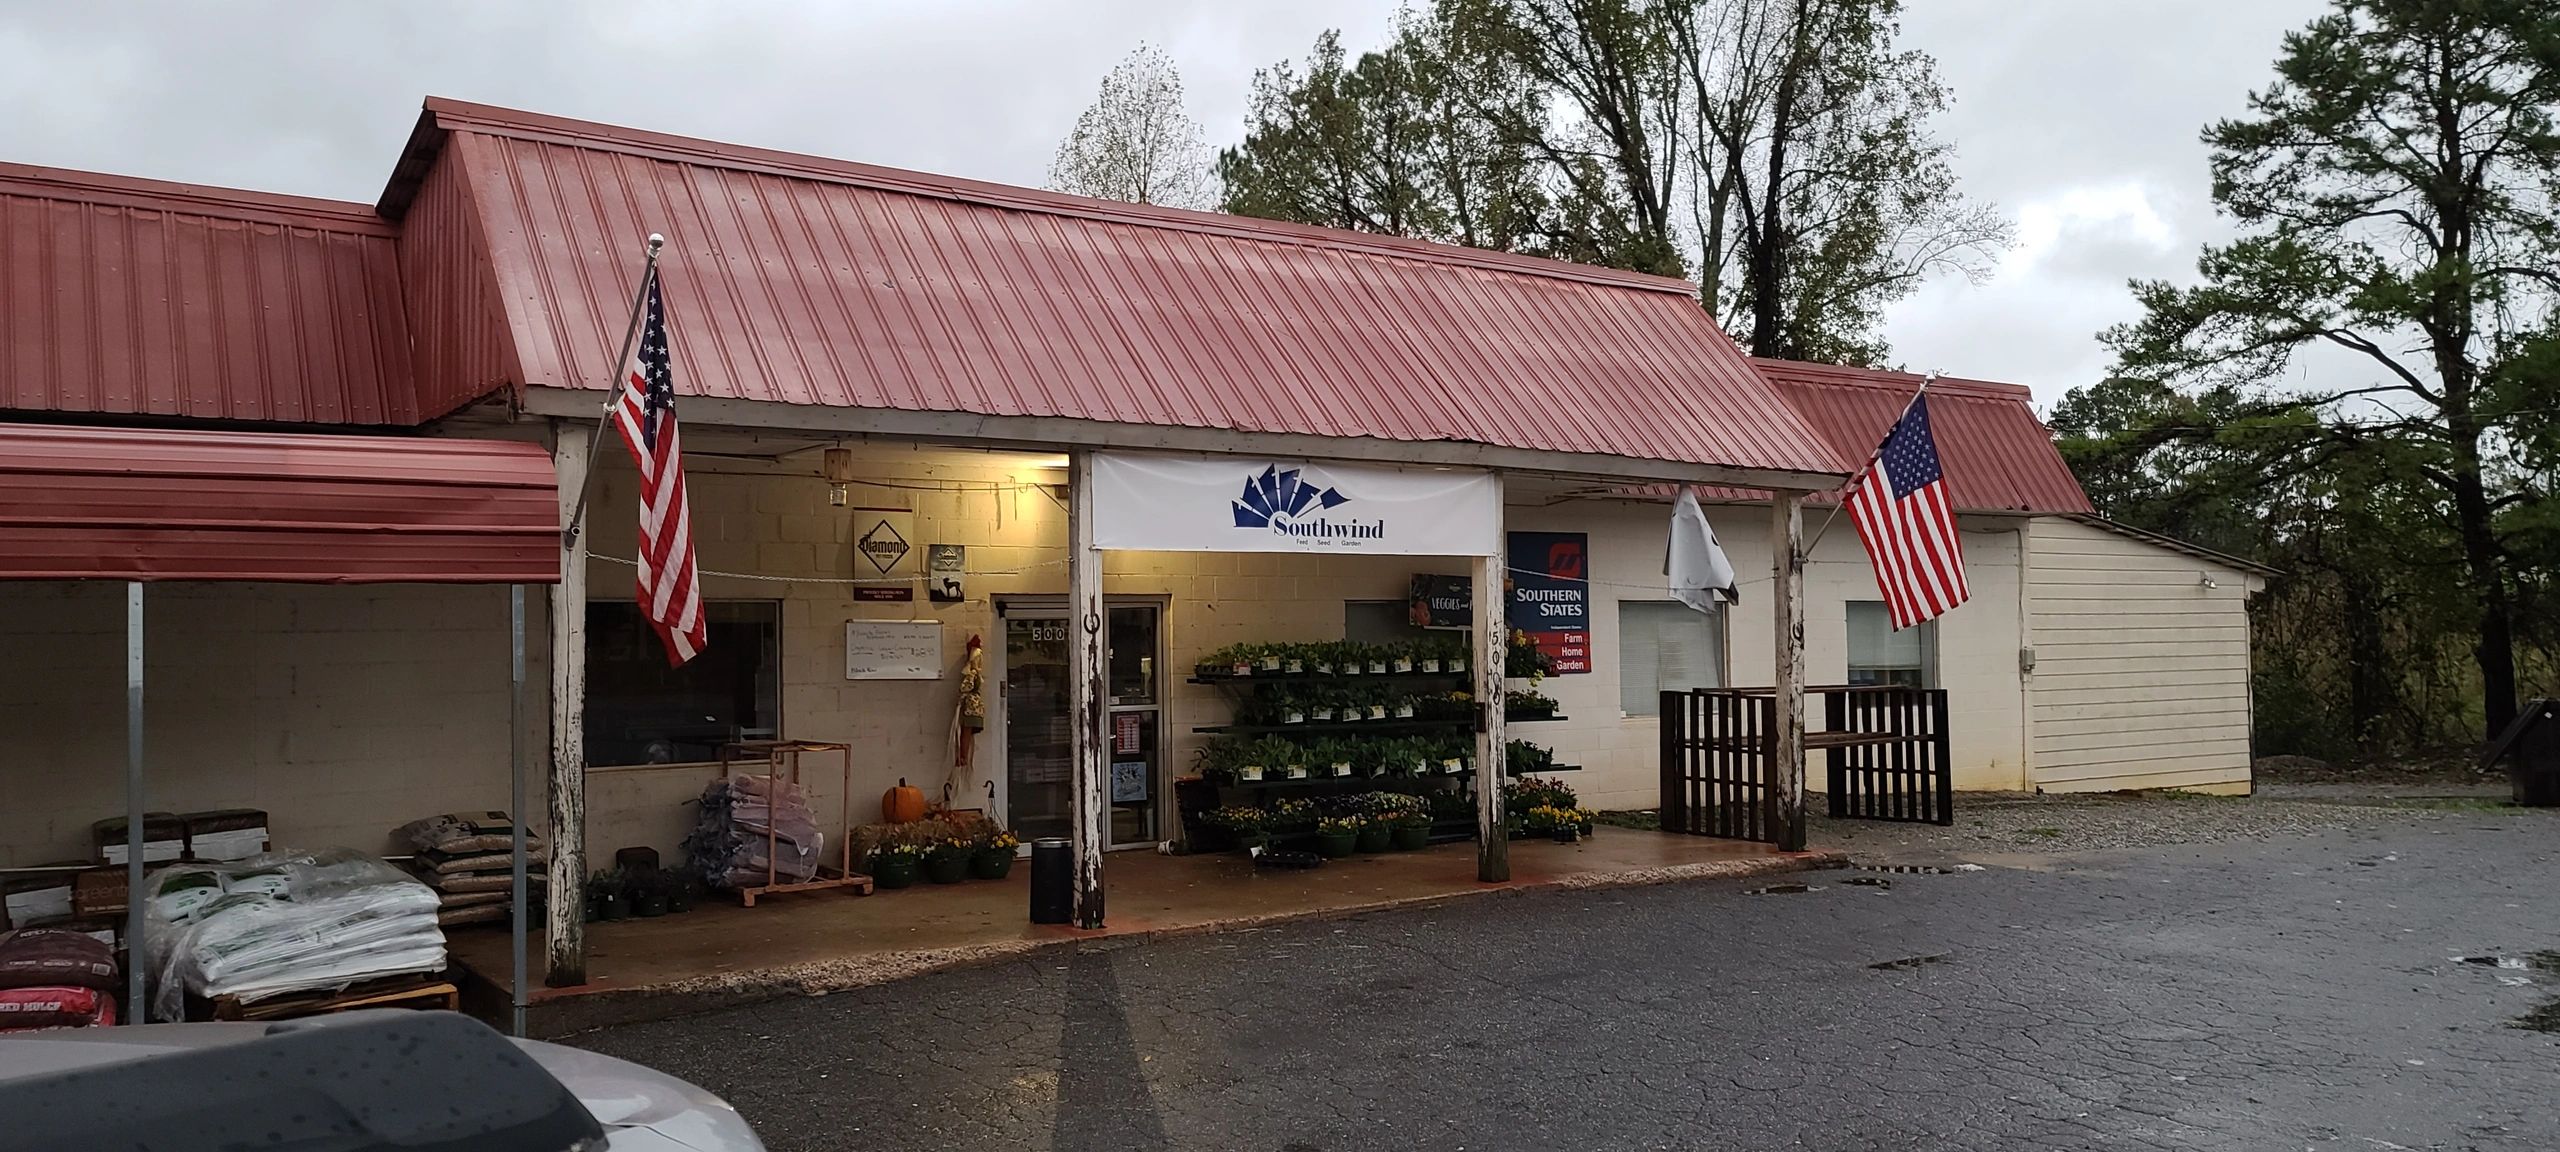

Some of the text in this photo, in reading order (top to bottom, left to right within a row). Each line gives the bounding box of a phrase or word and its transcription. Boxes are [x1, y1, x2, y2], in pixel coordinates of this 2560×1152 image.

[1273, 515, 1384, 539] Southwind
[859, 537, 907, 553] Diamond
[1516, 588, 1582, 602] SOUTHERN
[1431, 597, 1460, 610] VEGGIES
[1539, 603, 1583, 617] STATES
[1564, 633, 1583, 643] Farm
[1561, 646, 1583, 656] Home
[1556, 660, 1584, 670] Garden
